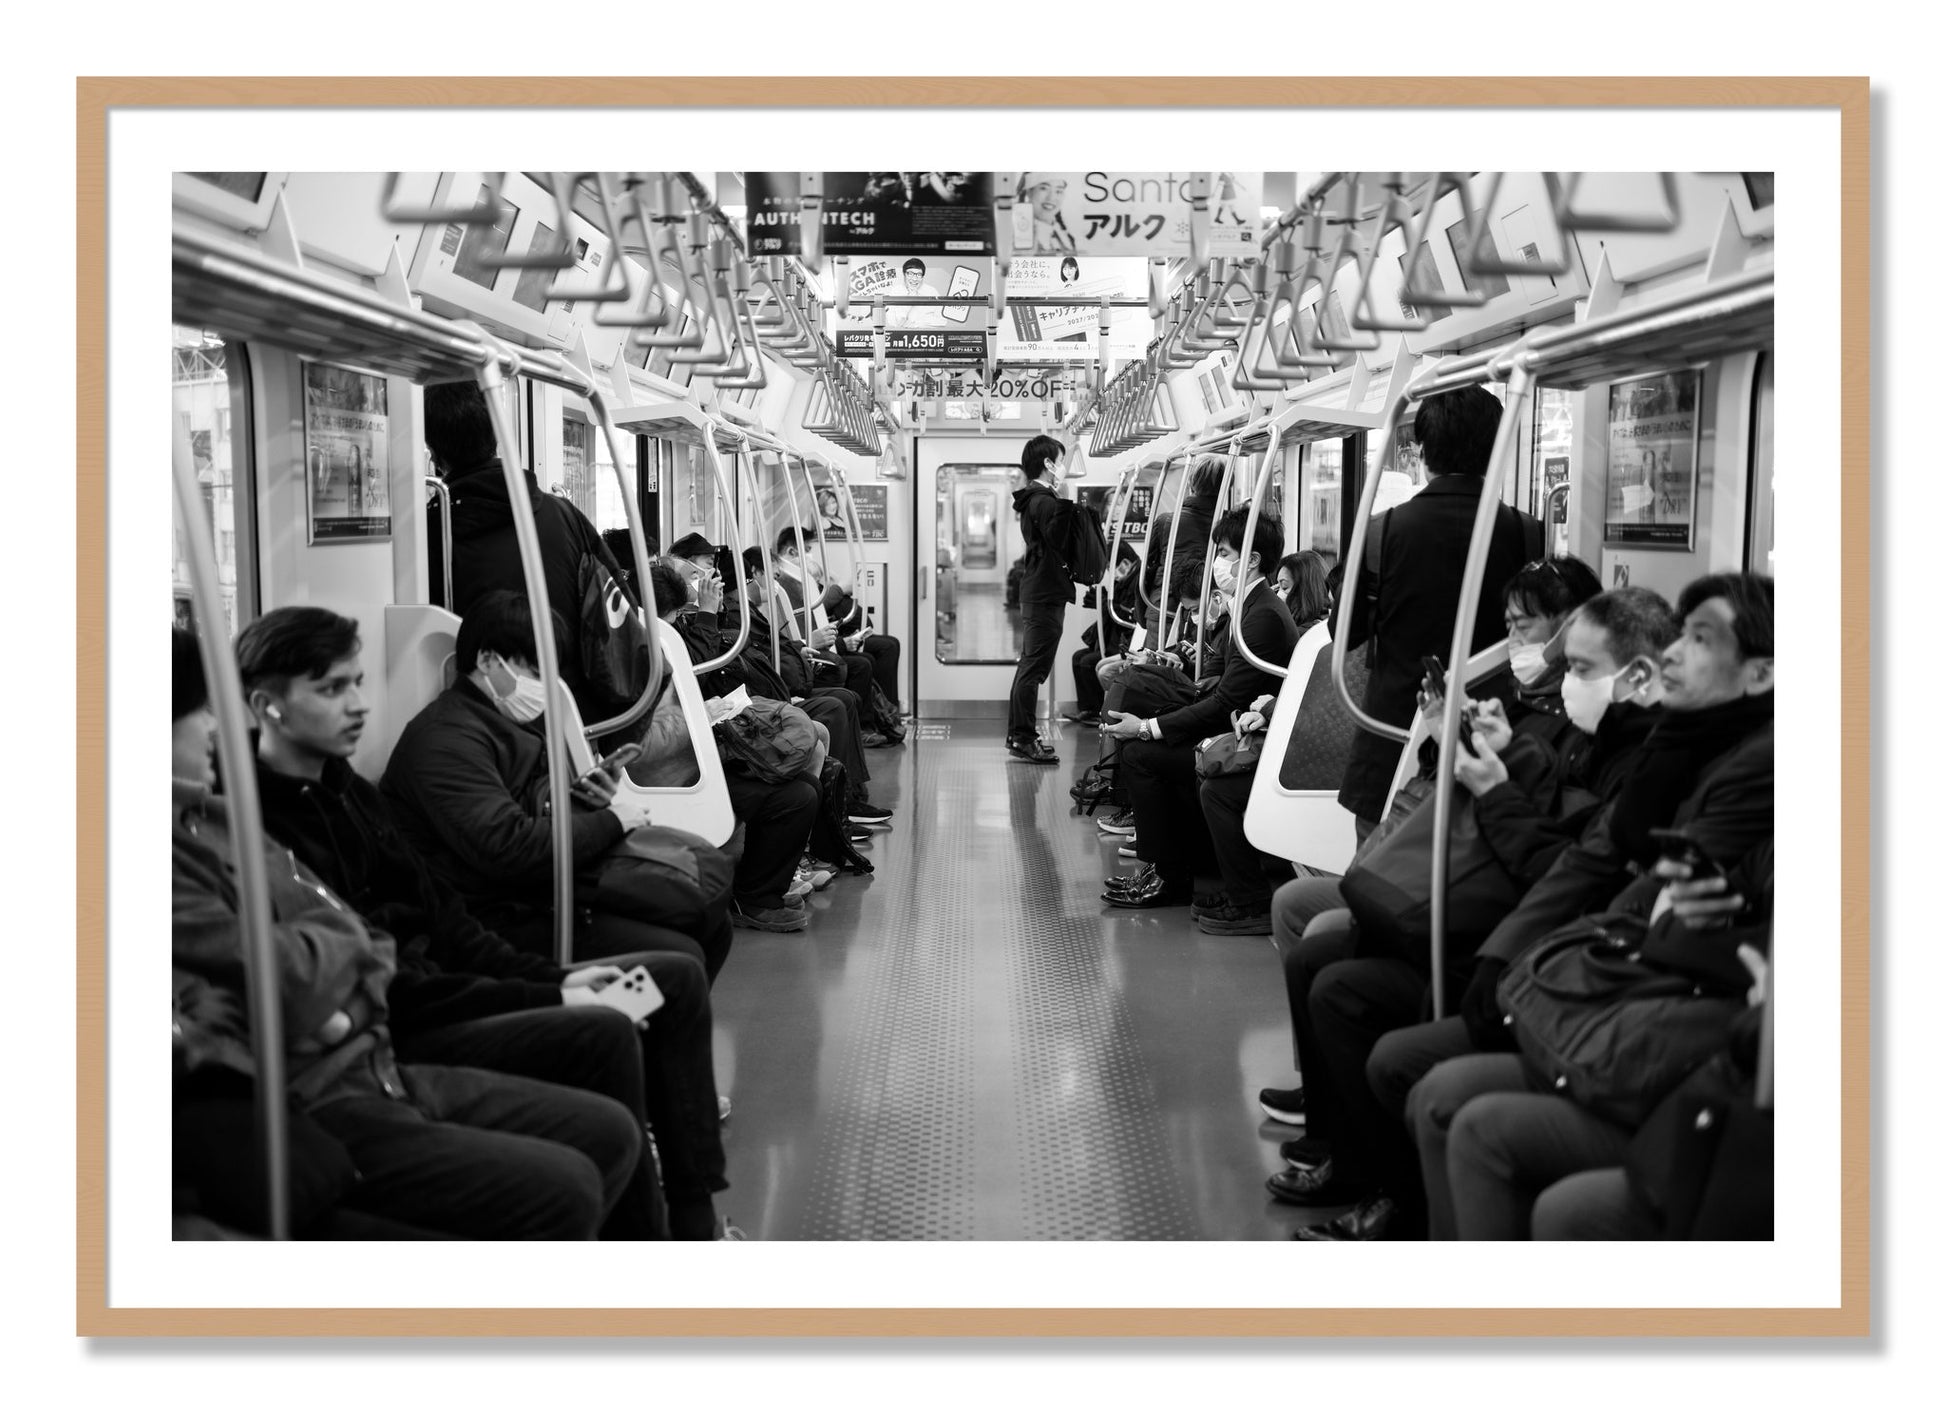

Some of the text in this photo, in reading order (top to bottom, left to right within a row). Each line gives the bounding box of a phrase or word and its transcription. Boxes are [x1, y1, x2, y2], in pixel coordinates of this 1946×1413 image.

[754, 211, 875, 226] AUTHTECH
[1083, 214, 1166, 241] アルク
[848, 268, 897, 296] AGA診療
[849, 261, 887, 282] スマホで
[1067, 312, 1099, 326] 2027/202
